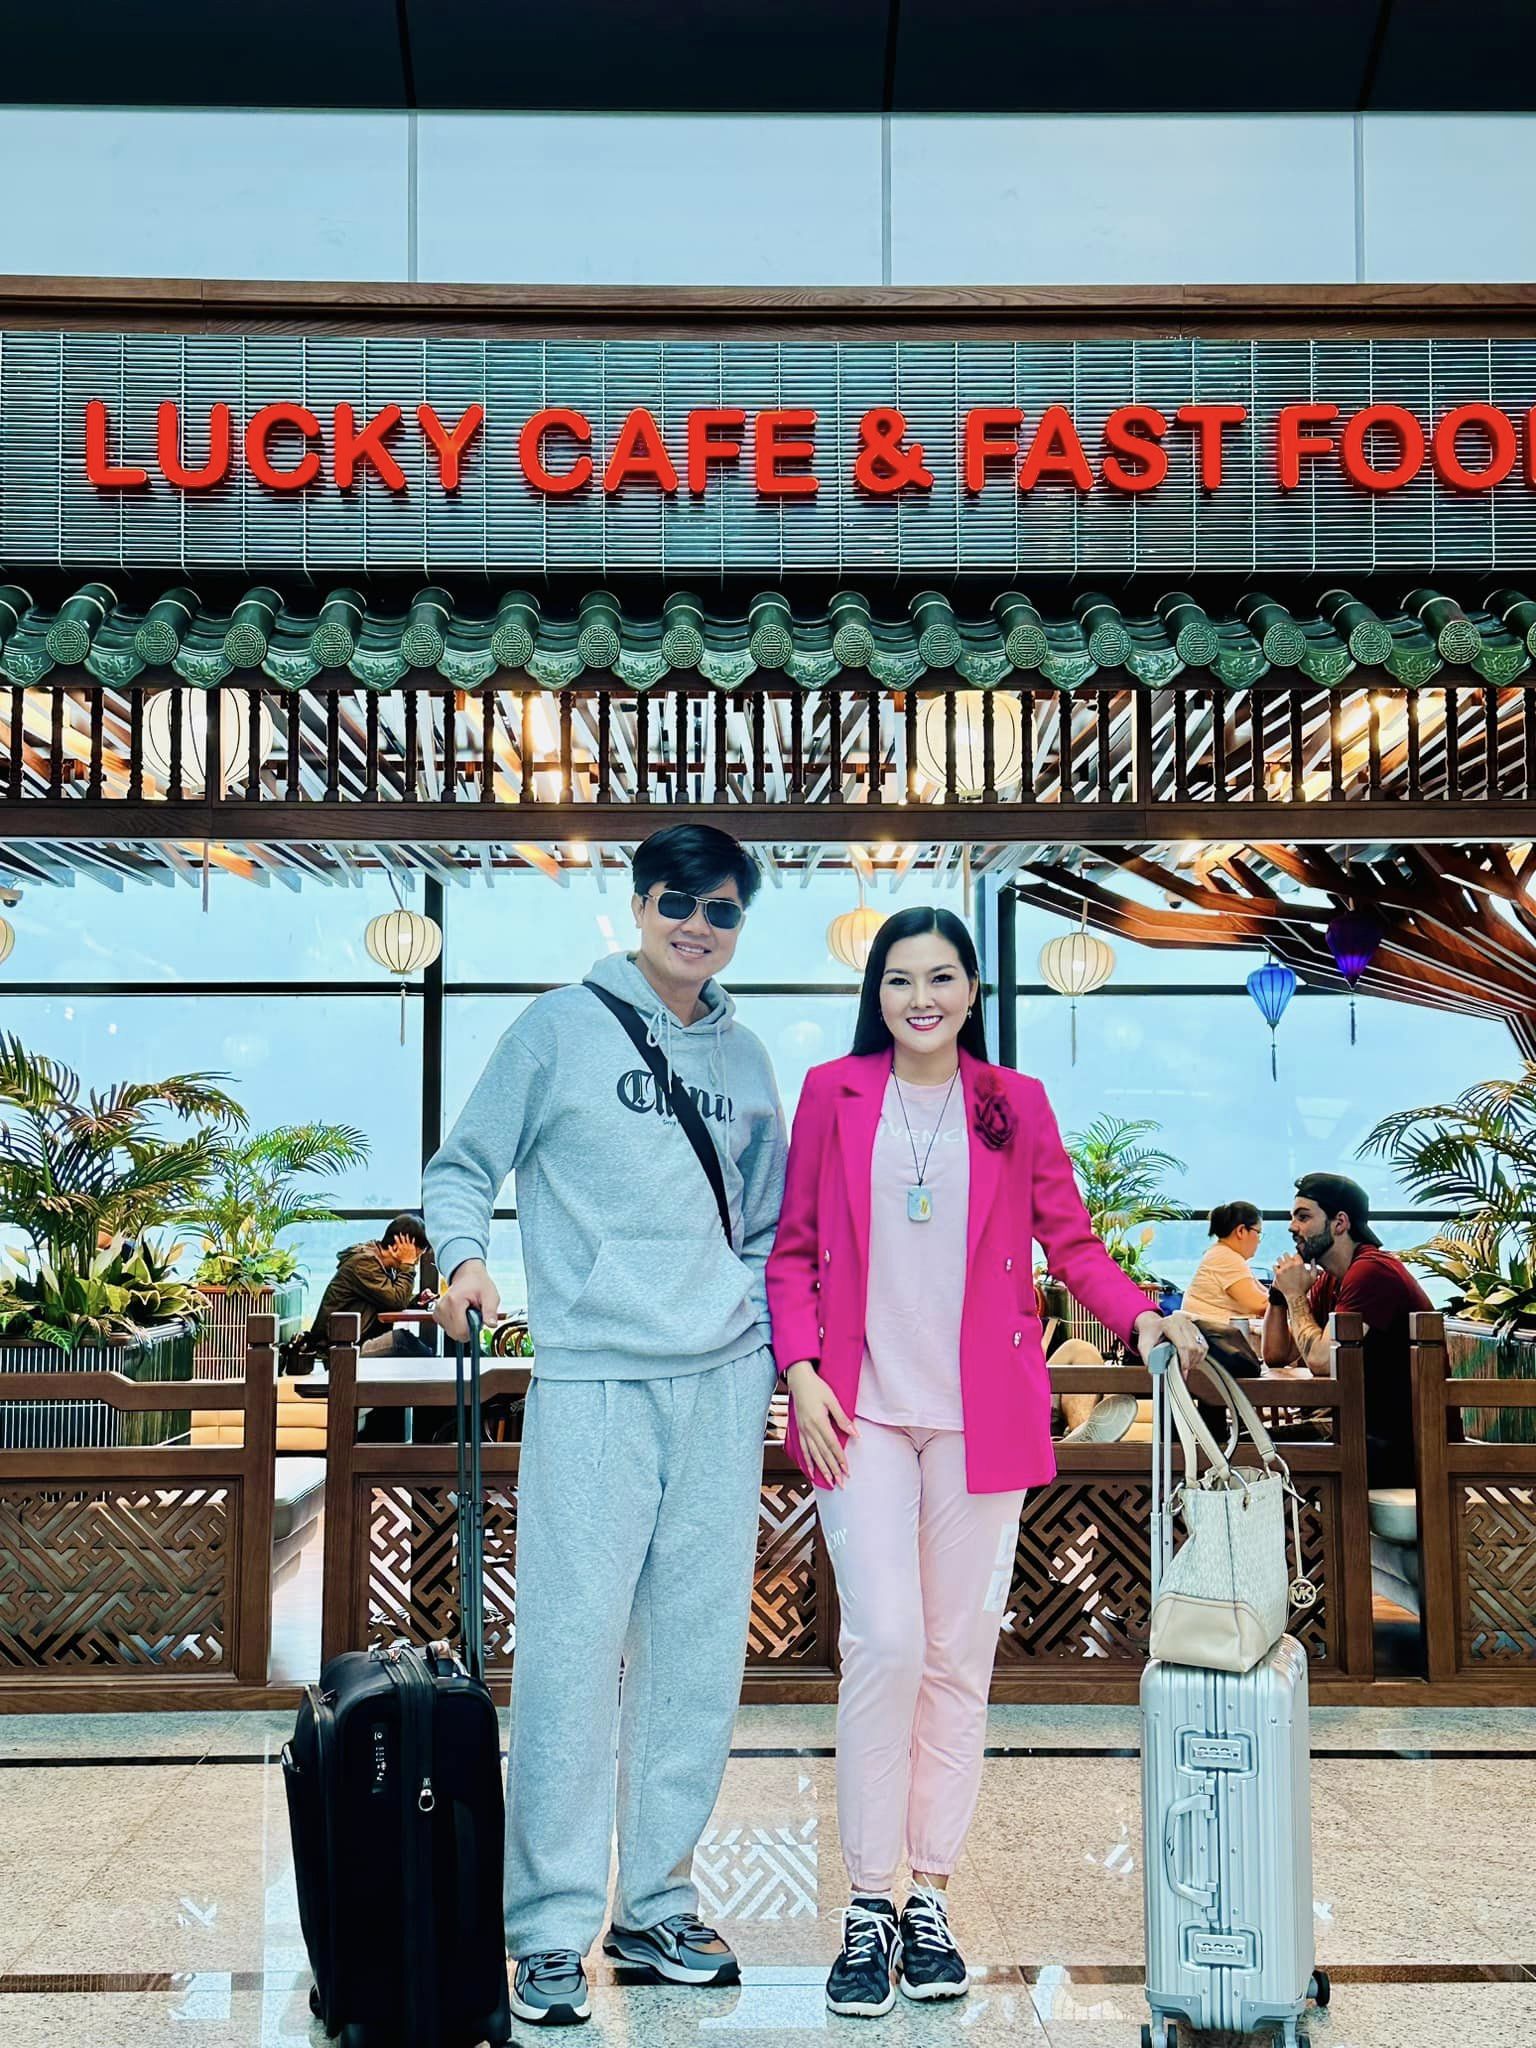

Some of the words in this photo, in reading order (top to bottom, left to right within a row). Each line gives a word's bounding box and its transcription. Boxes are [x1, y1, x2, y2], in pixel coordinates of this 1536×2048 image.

[85, 400, 484, 490] LUCKY
[518, 407, 820, 494] CAFE
[855, 407, 934, 493] &
[964, 404, 1247, 492] FAST
[1277, 403, 1536, 490] FOO
